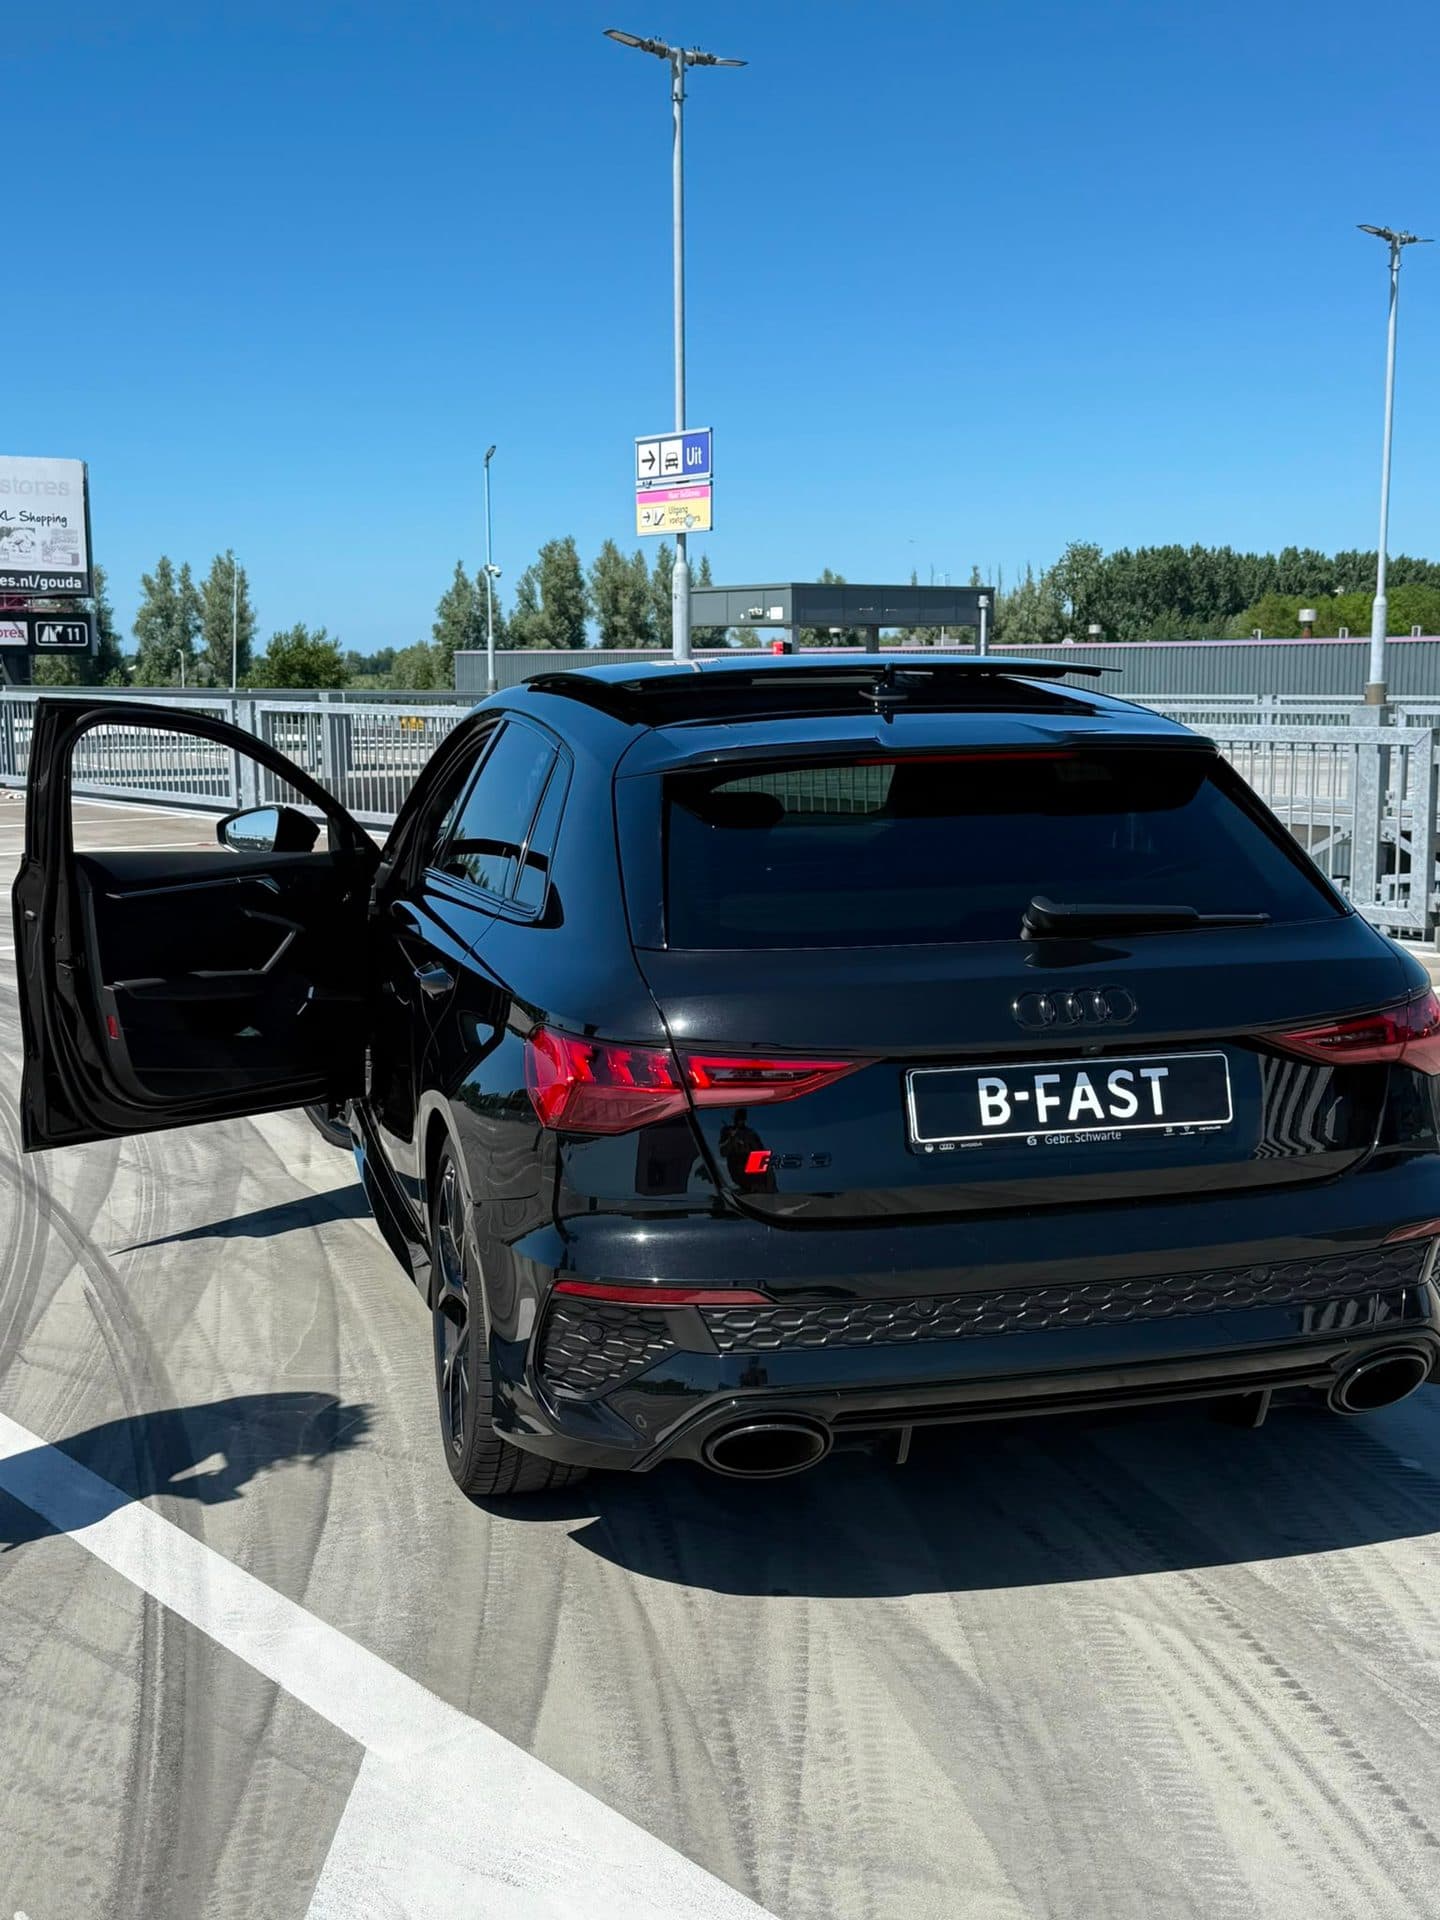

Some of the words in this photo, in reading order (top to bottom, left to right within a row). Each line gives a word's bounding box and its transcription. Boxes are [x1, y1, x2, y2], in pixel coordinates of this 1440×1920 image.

[686, 447, 702, 466] Uit
[0, 477, 70, 497] stores
[19, 510, 68, 528] Shopping
[66, 628, 80, 641] 11
[977, 1067, 1169, 1126] B-FAST
[1045, 1132, 1073, 1145] Gebr.
[1074, 1130, 1122, 1143] Schwarte
